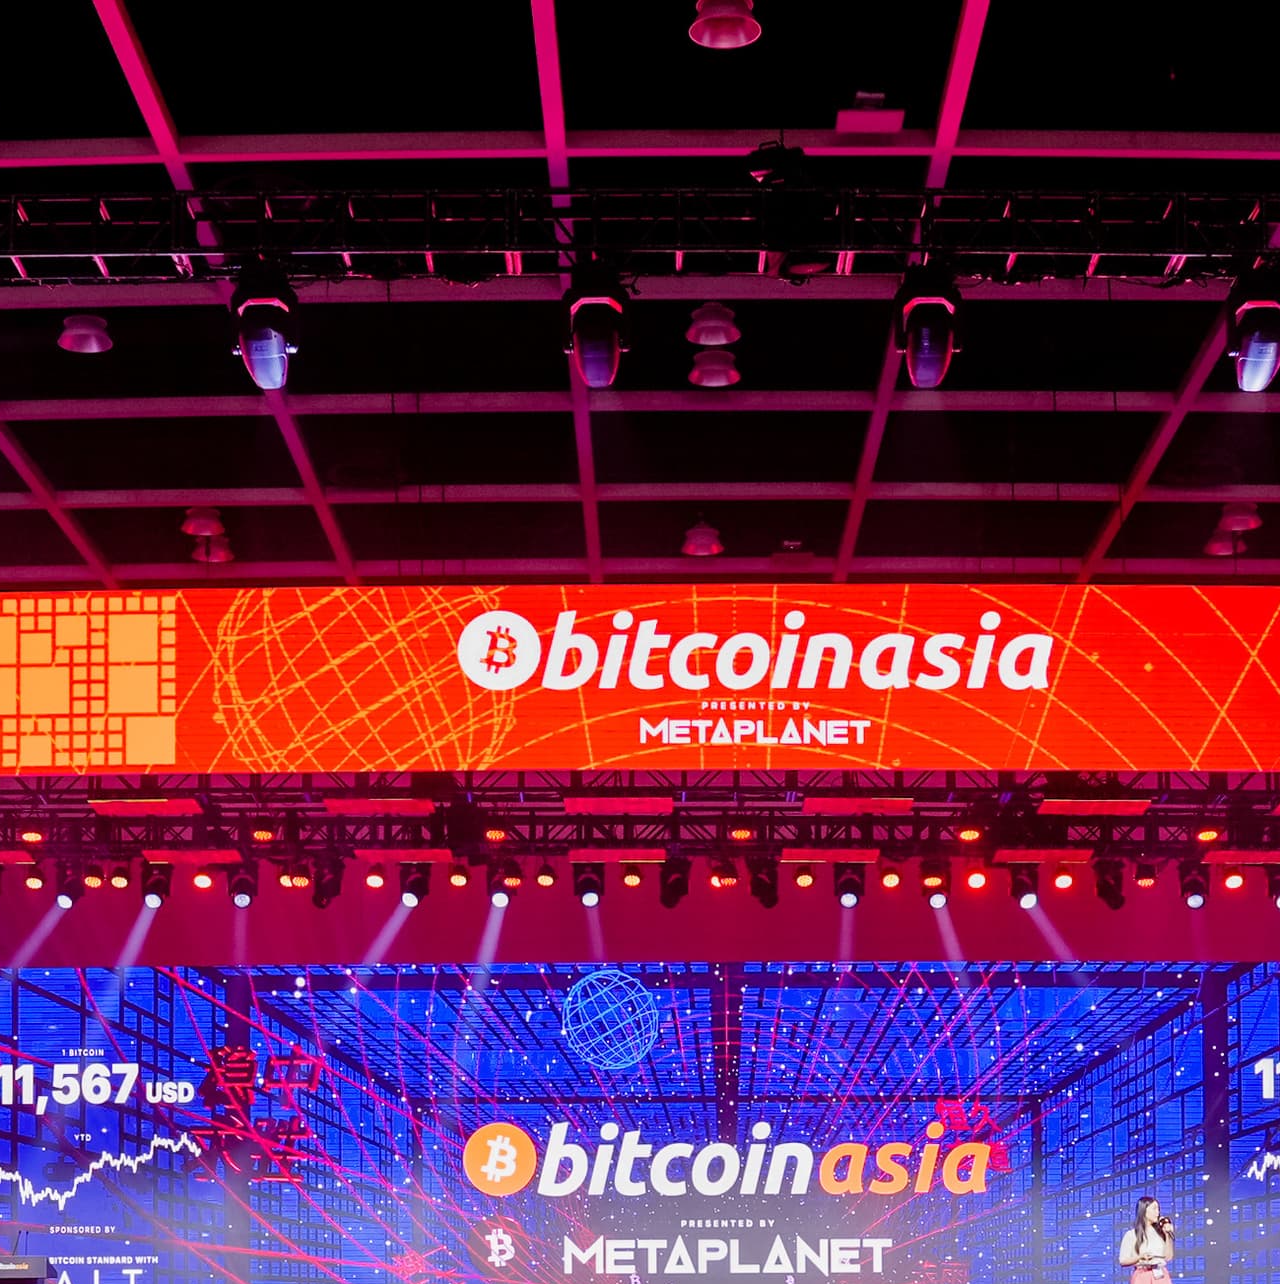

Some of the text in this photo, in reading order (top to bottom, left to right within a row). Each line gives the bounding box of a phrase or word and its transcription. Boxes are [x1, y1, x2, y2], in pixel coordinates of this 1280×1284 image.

[541, 610, 1054, 690] bitcoinasia
[701, 701, 811, 711] PRESENTED BY
[639, 717, 871, 746] METAPLANET
[69, 1048, 105, 1056] BITCOIN
[145, 1081, 195, 1103] USD
[73, 1134, 92, 1142] YTD
[538, 1121, 991, 1196] bitcoinasia
[680, 1219, 775, 1228] PRESENTED BY
[49, 1226, 116, 1234] SPONSORED BY
[86, 1256, 133, 1265] STANDARD
[134, 1256, 159, 1264] WITH
[563, 1234, 892, 1277] METAPLANET
